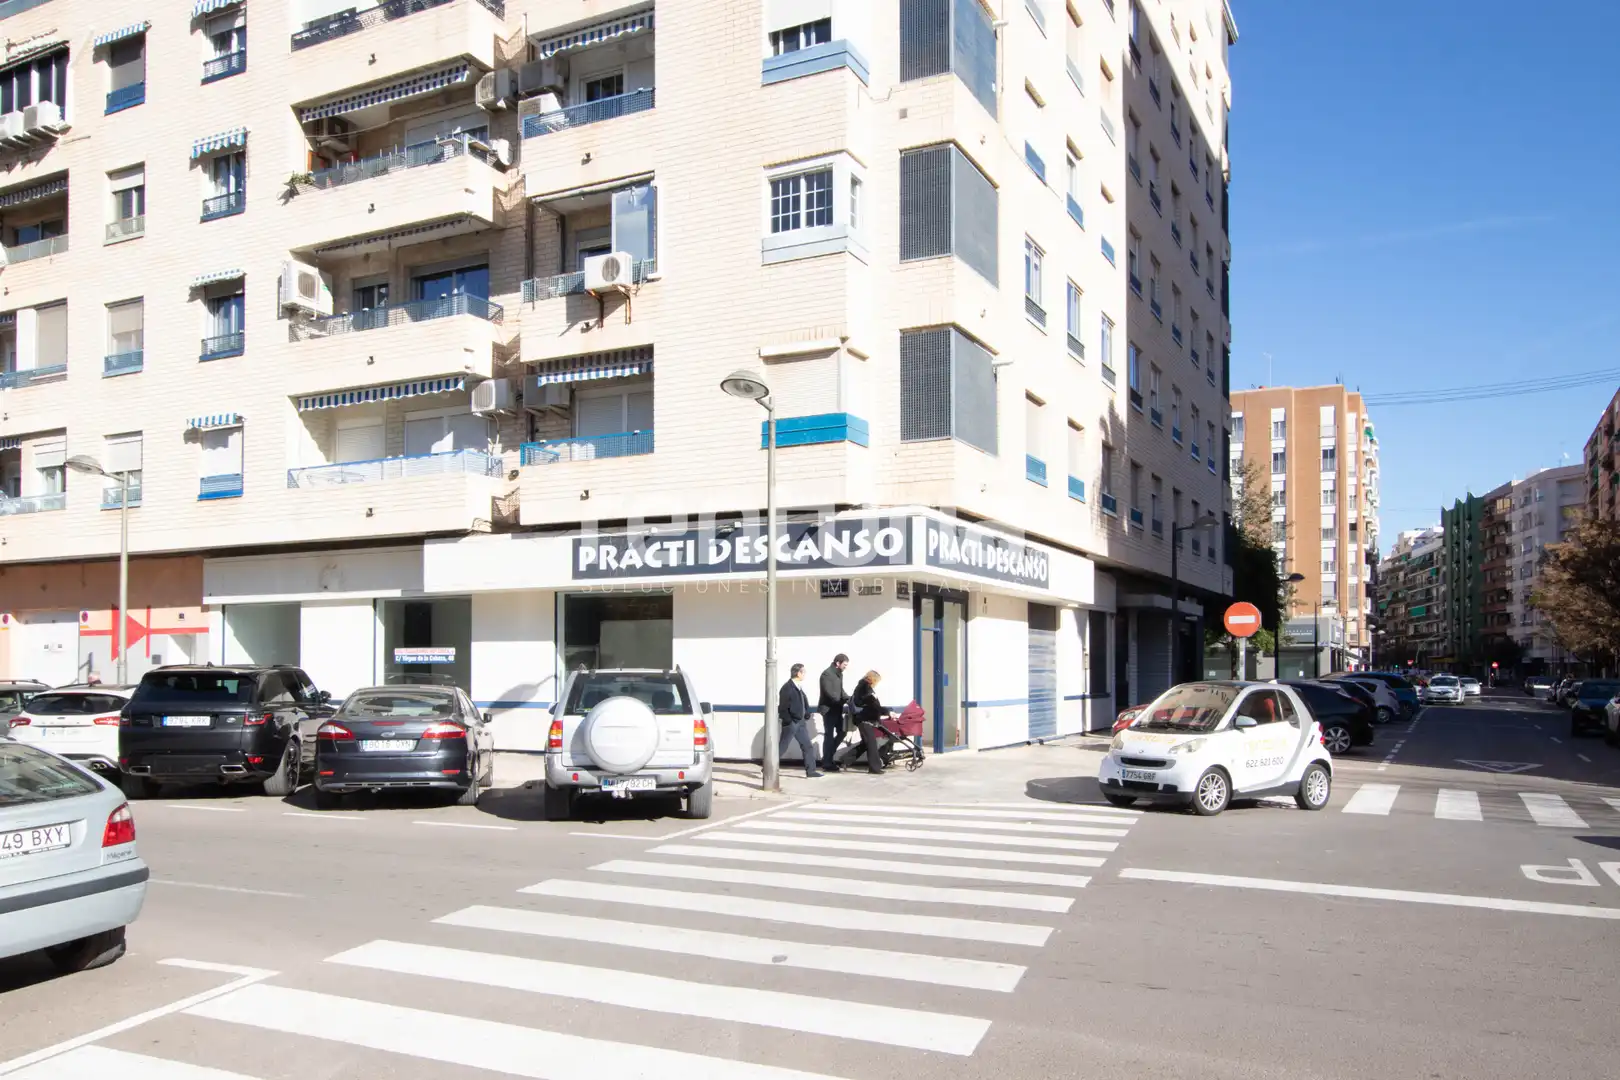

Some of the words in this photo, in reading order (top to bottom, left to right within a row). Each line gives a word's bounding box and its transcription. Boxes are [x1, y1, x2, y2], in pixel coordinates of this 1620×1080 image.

[578, 540, 695, 571] PRACTI
[708, 526, 903, 566] DESCANSO
[928, 527, 983, 568] PRACTI
[986, 550, 1047, 582] DESCANSO
[1, 833, 23, 851] 49
[32, 827, 64, 846] BXY
